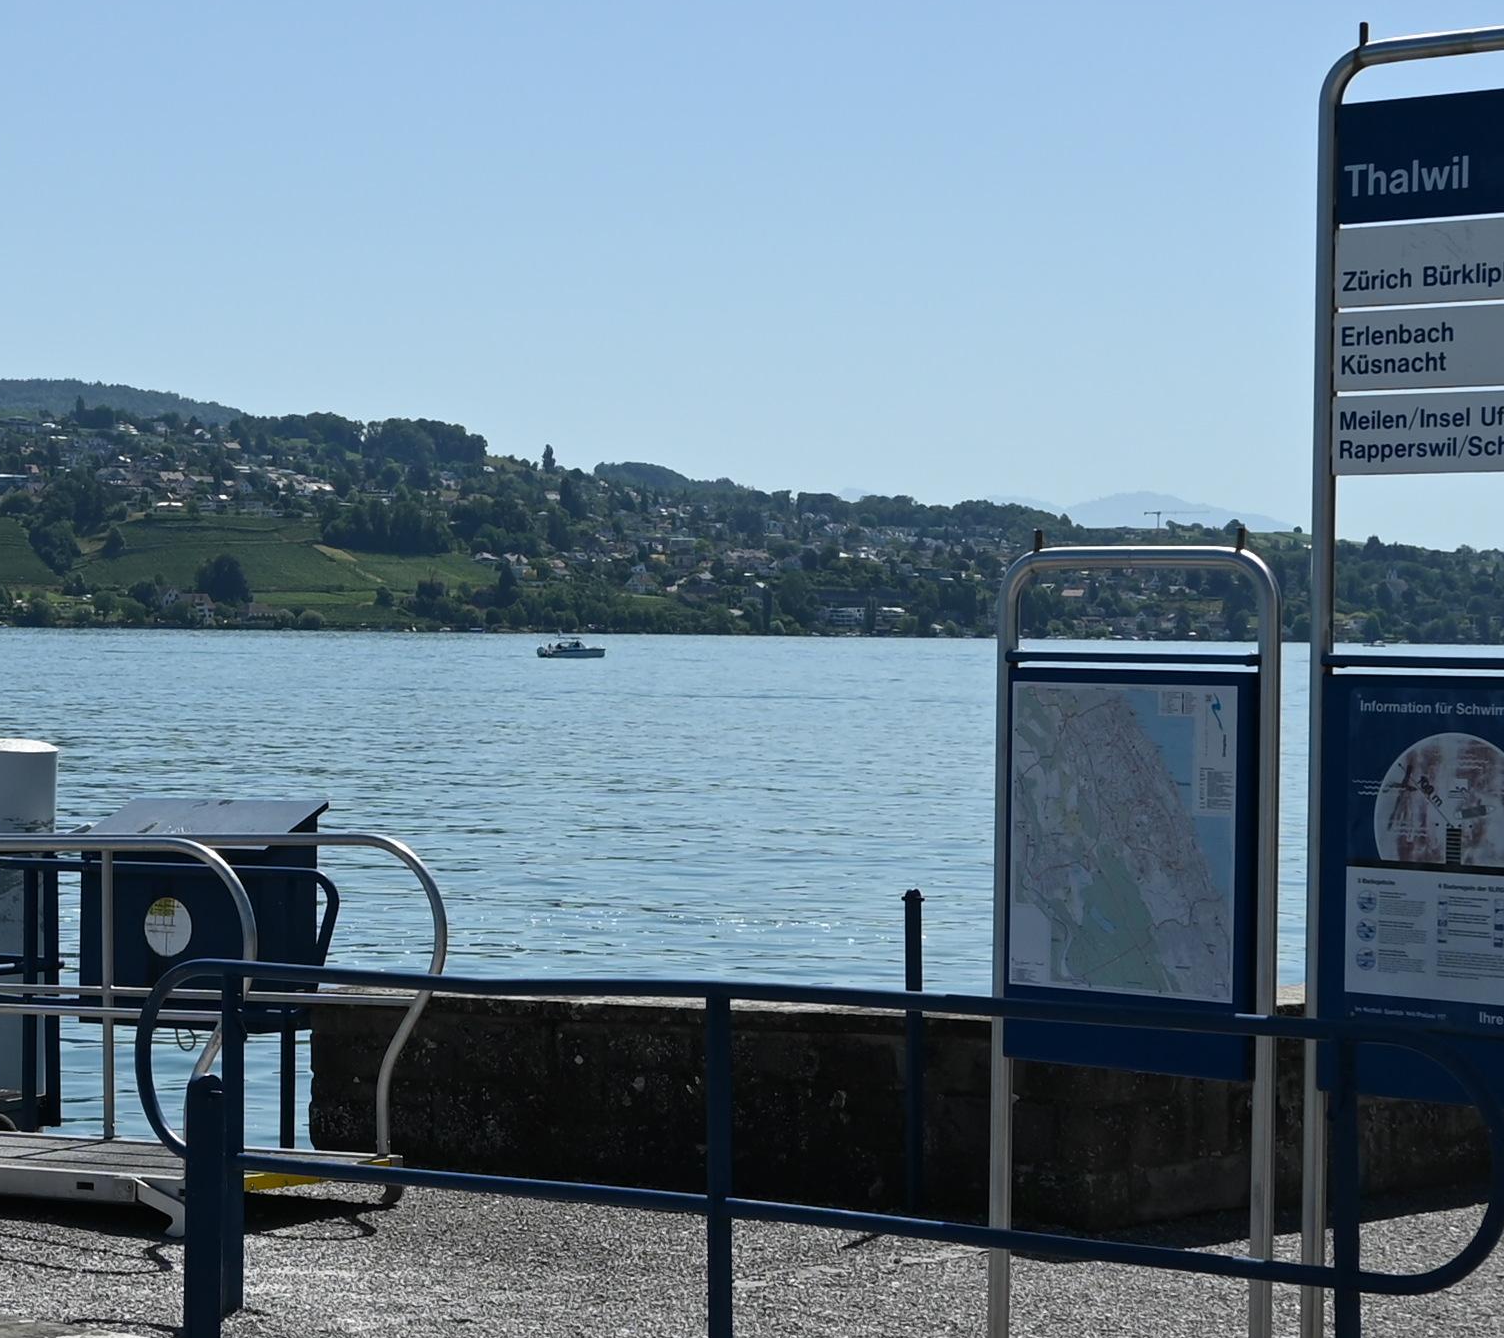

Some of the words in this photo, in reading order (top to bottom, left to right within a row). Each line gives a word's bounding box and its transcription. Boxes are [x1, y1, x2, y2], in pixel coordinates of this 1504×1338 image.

[1344, 155, 1470, 197] Thalwil
[1343, 267, 1413, 292] Zürich
[1341, 322, 1454, 347] Erlenbach
[1340, 352, 1447, 375] Küsnacht
[1339, 406, 1471, 431] Meilen/Insel
[1360, 699, 1432, 714] Information
[1435, 702, 1453, 715] für
[1417, 776, 1434, 795] 100
[1432, 795, 1443, 807] m
[1478, 1011, 1503, 1025] Ihre
